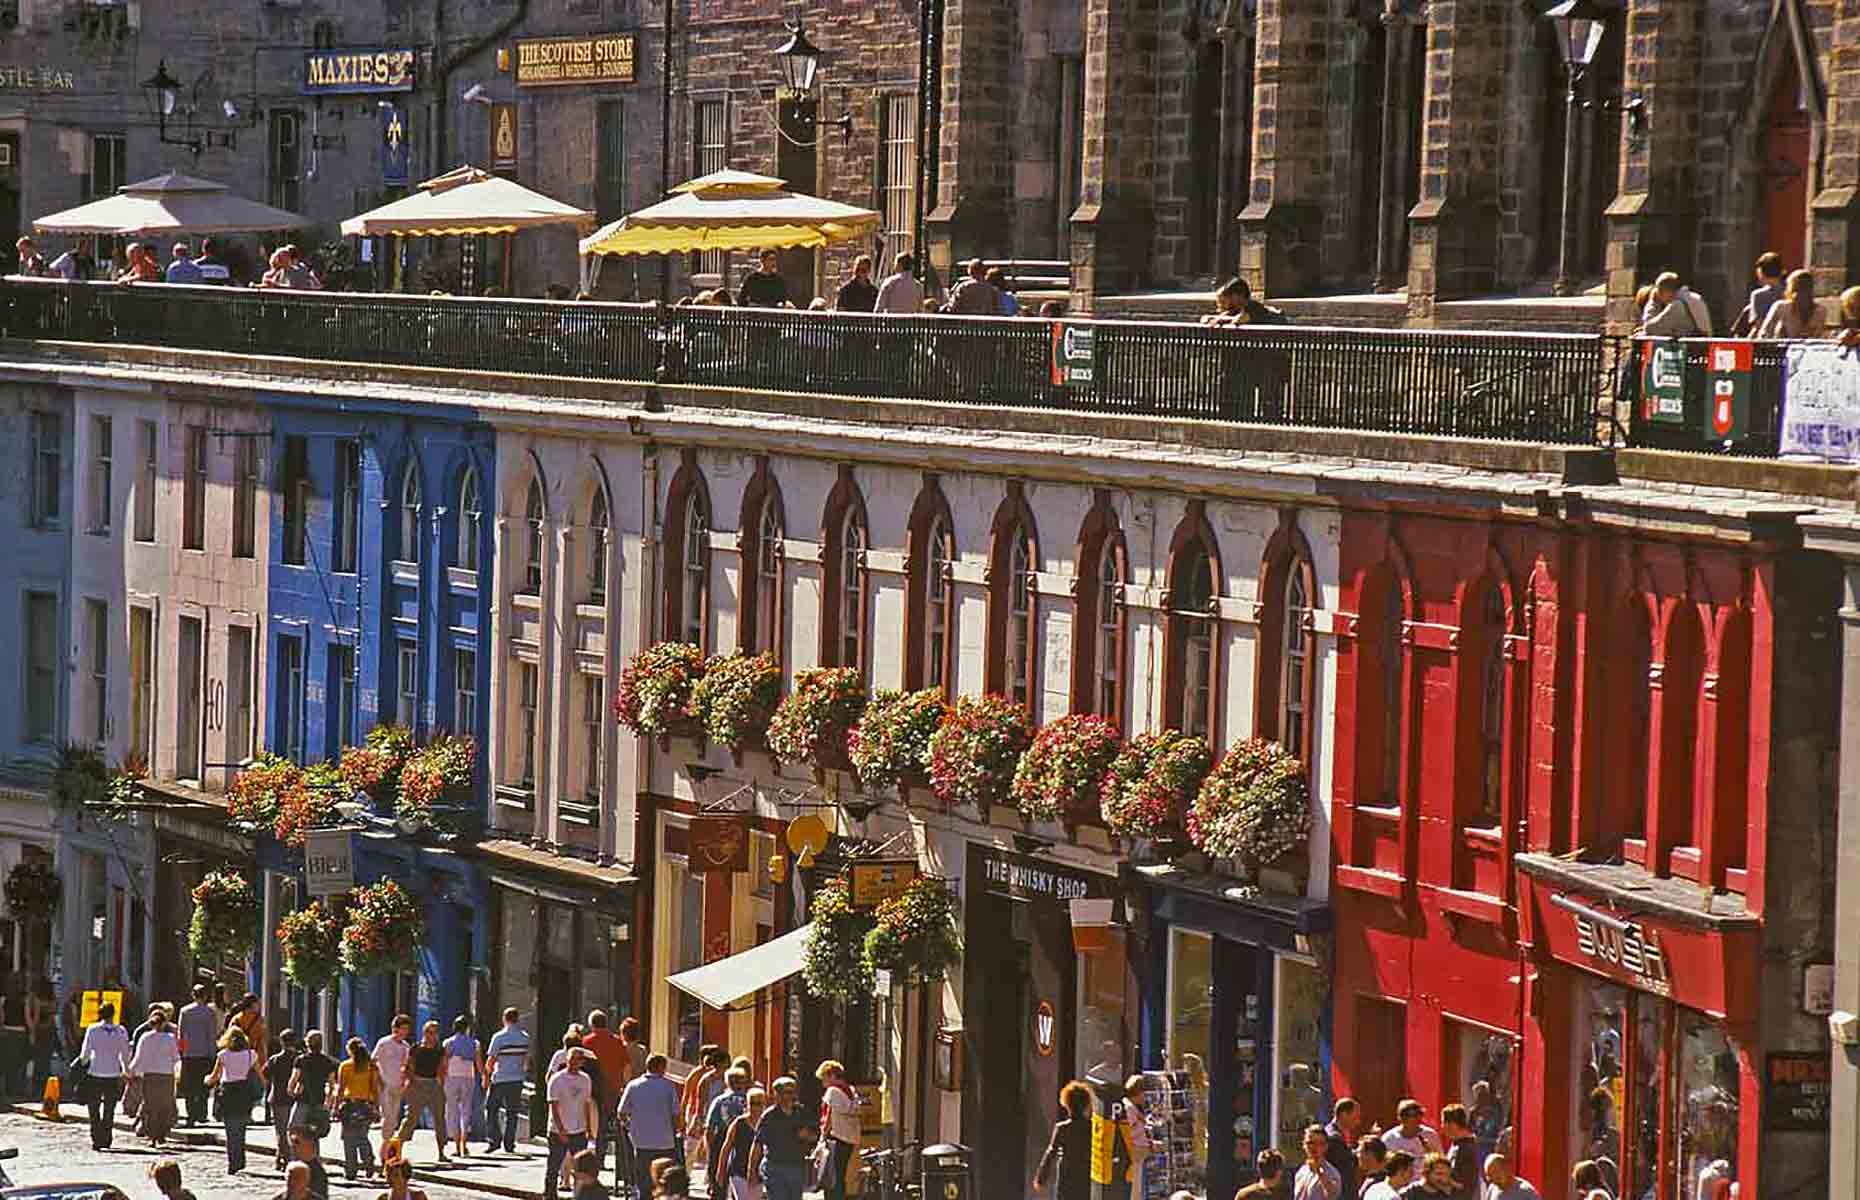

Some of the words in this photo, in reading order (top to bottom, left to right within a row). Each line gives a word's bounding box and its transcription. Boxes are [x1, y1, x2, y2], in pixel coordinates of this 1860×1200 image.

[518, 43, 538, 64] THE
[540, 41, 592, 63] SCOTTISH
[595, 38, 634, 61] STORE
[42, 71, 73, 89] BAR
[308, 53, 389, 85] MAXIES
[984, 858, 1008, 882] THE
[1009, 864, 1054, 894] WHISKY
[1056, 876, 1088, 899] SHOP
[1038, 1013, 1053, 1046] W
